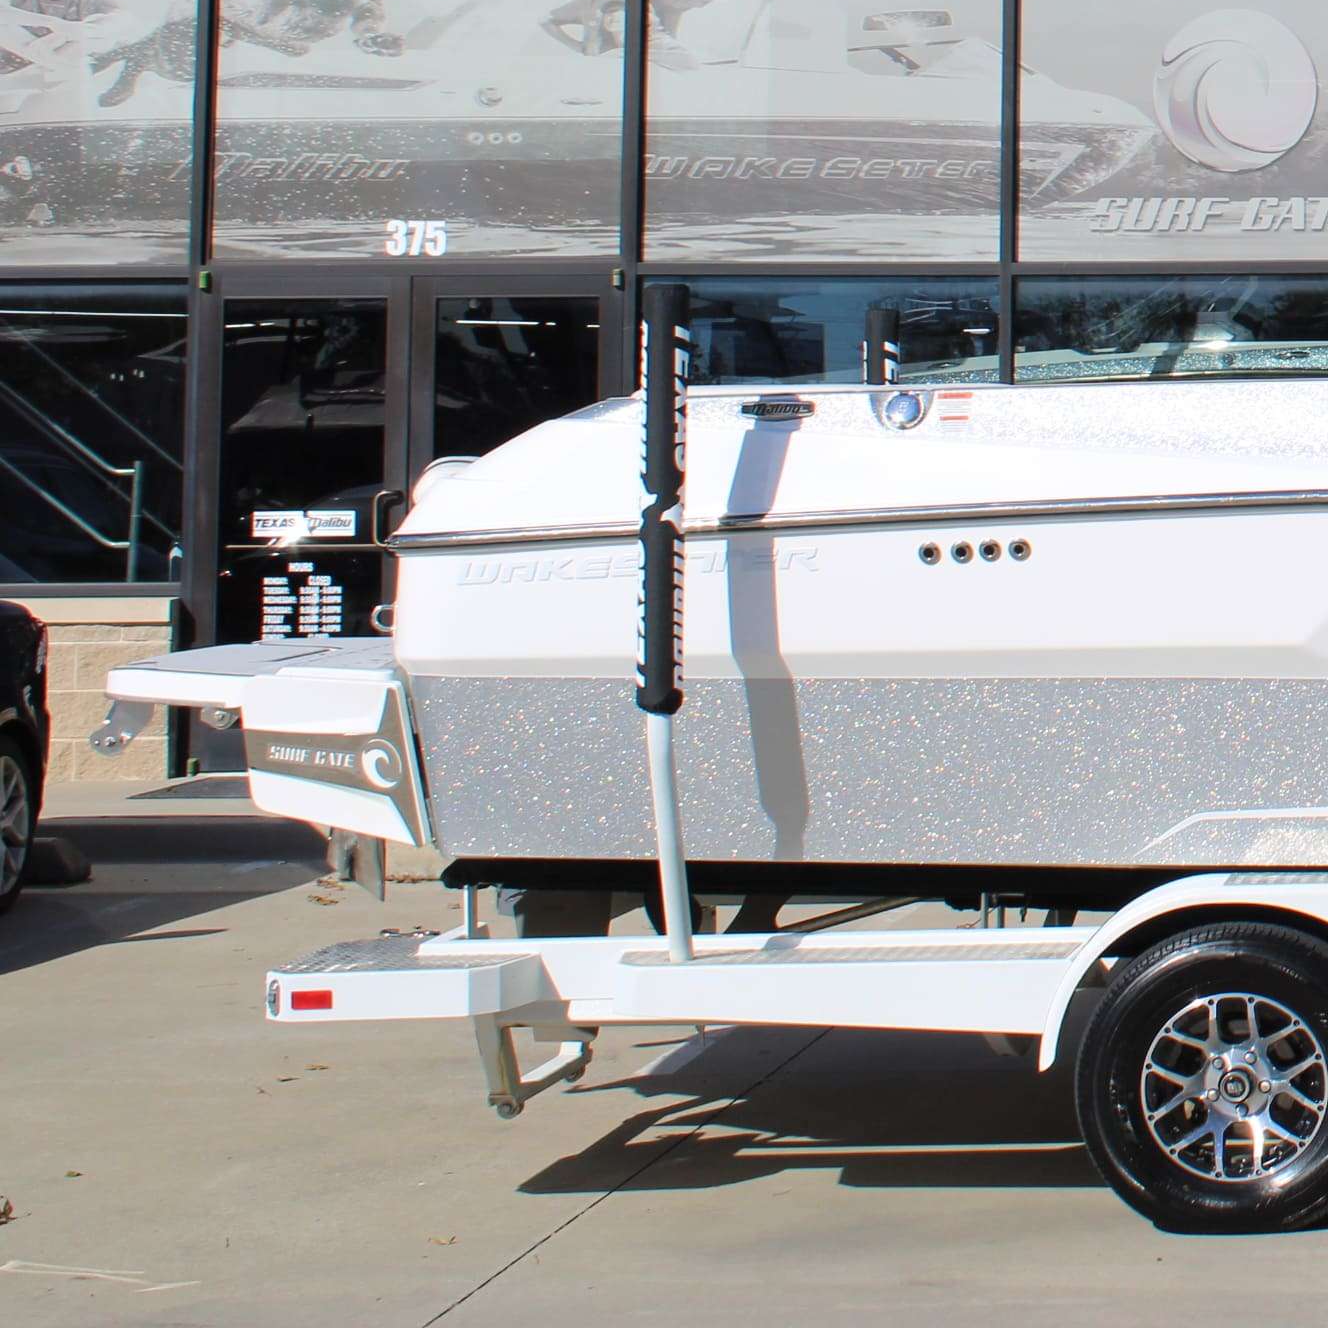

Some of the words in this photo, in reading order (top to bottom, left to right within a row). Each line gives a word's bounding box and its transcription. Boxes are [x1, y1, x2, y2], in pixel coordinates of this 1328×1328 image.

[1090, 197, 1230, 232] SURF
[385, 220, 448, 256] 375
[255, 518, 296, 528] TEXAS
